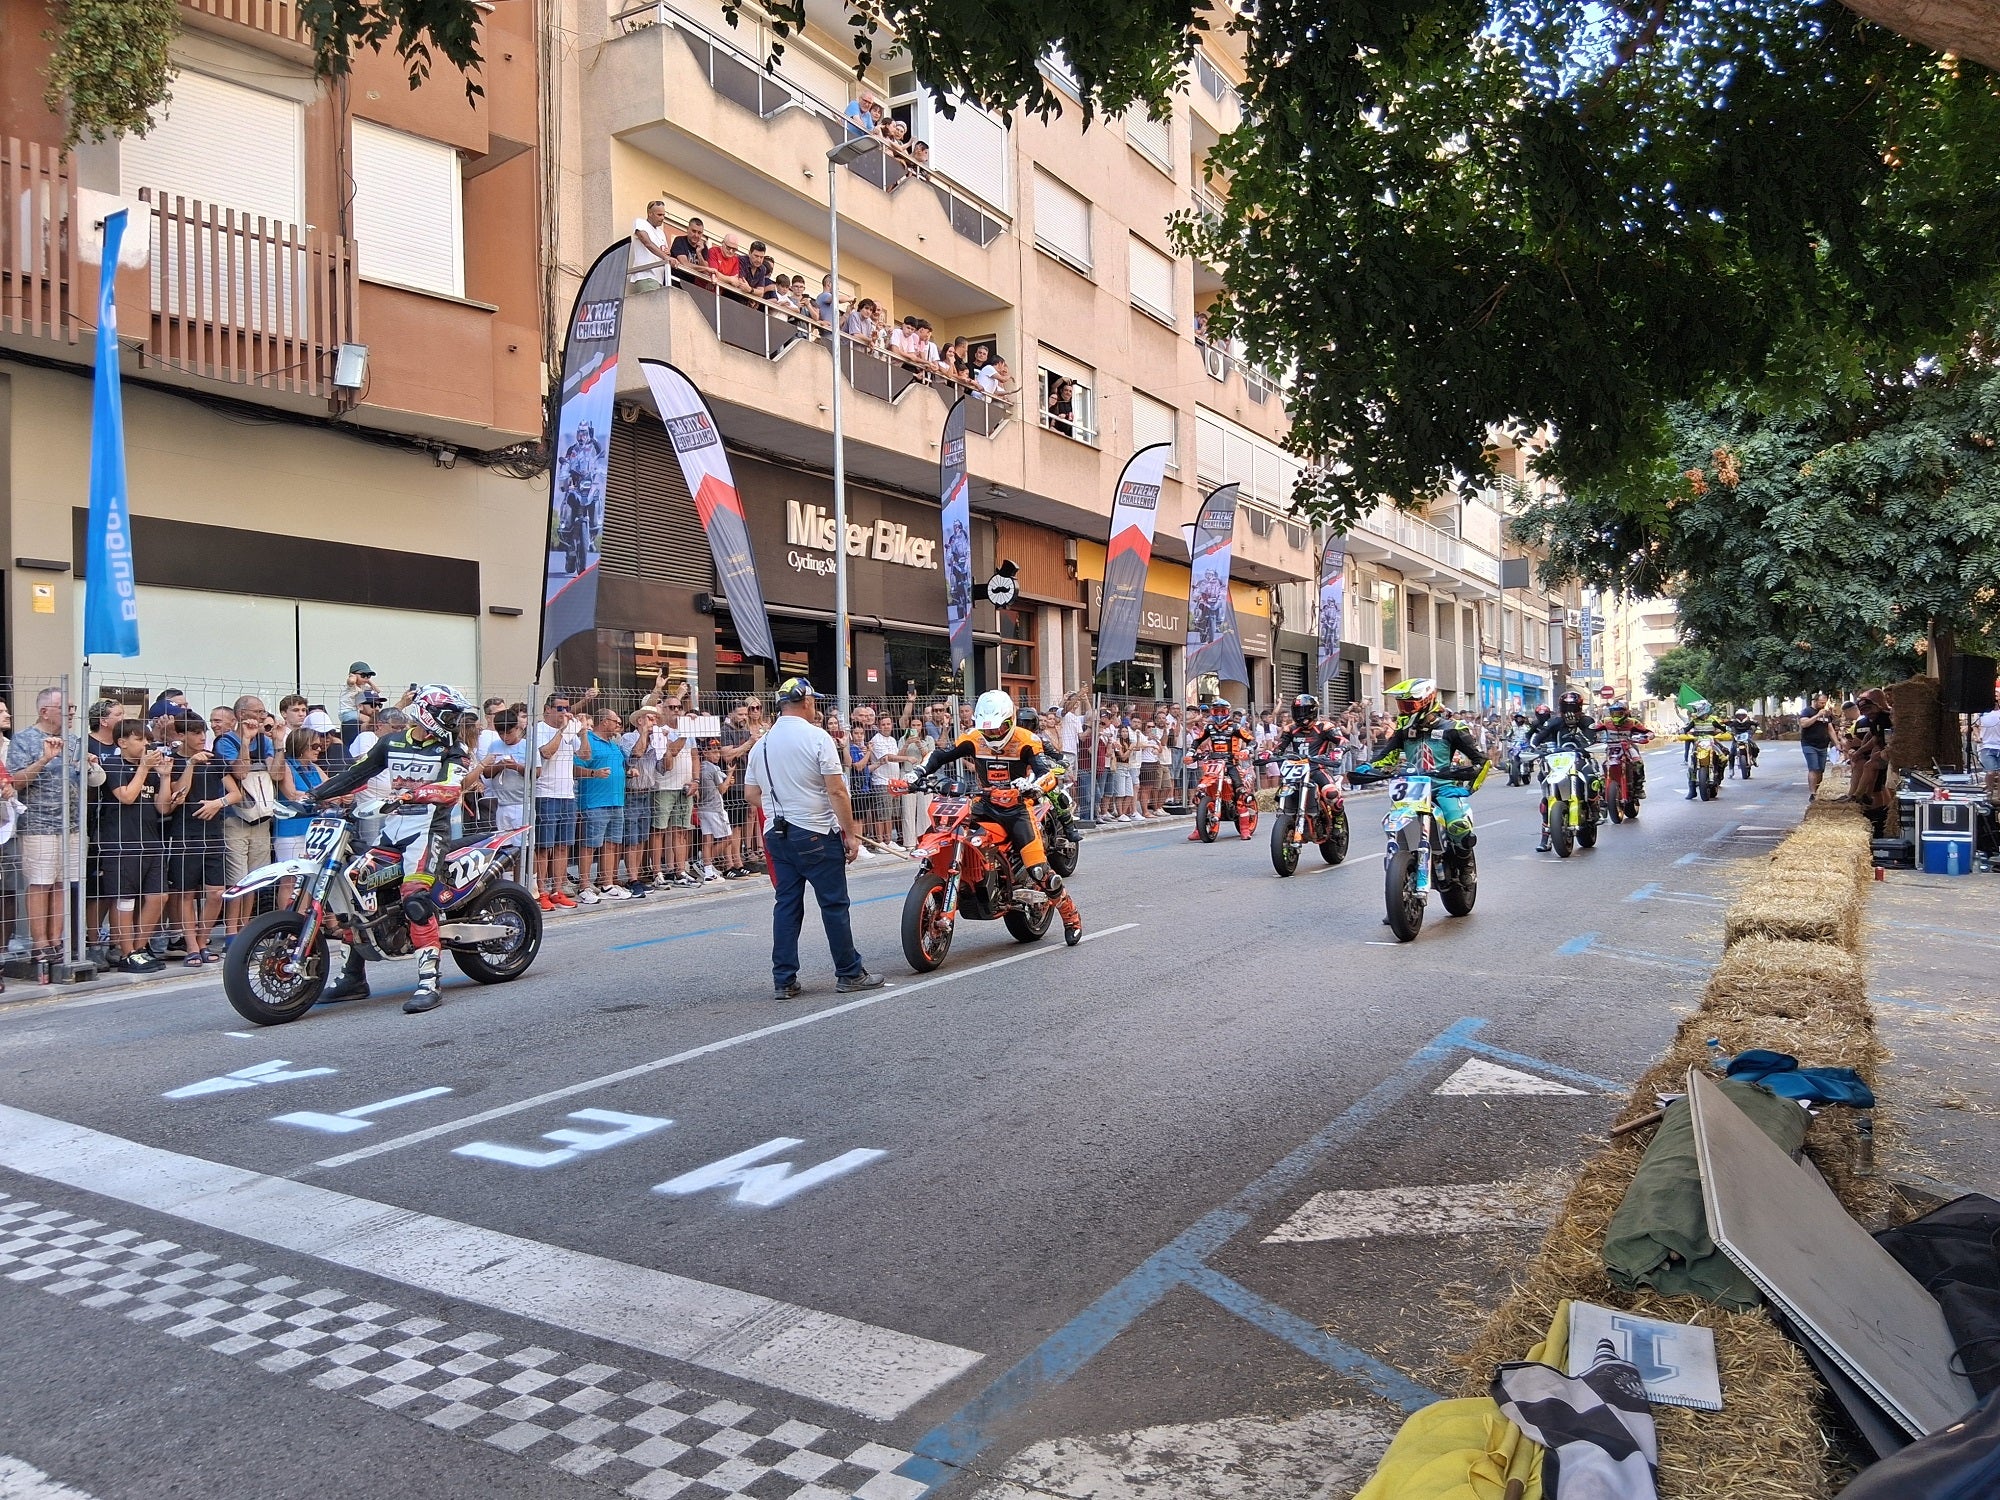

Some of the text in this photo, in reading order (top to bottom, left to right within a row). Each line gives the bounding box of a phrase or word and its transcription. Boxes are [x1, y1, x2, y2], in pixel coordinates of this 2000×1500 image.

[1127, 484, 1160, 498] XTREME
[1121, 495, 1155, 508] CHALLENGE
[787, 549, 825, 577] Cycling
[391, 762, 434, 774] EVO-1
[1282, 765, 1306, 778] 73
[1391, 782, 1426, 802] 34
[934, 804, 963, 816] 15
[306, 827, 335, 850] 222
[448, 849, 490, 890] 222
